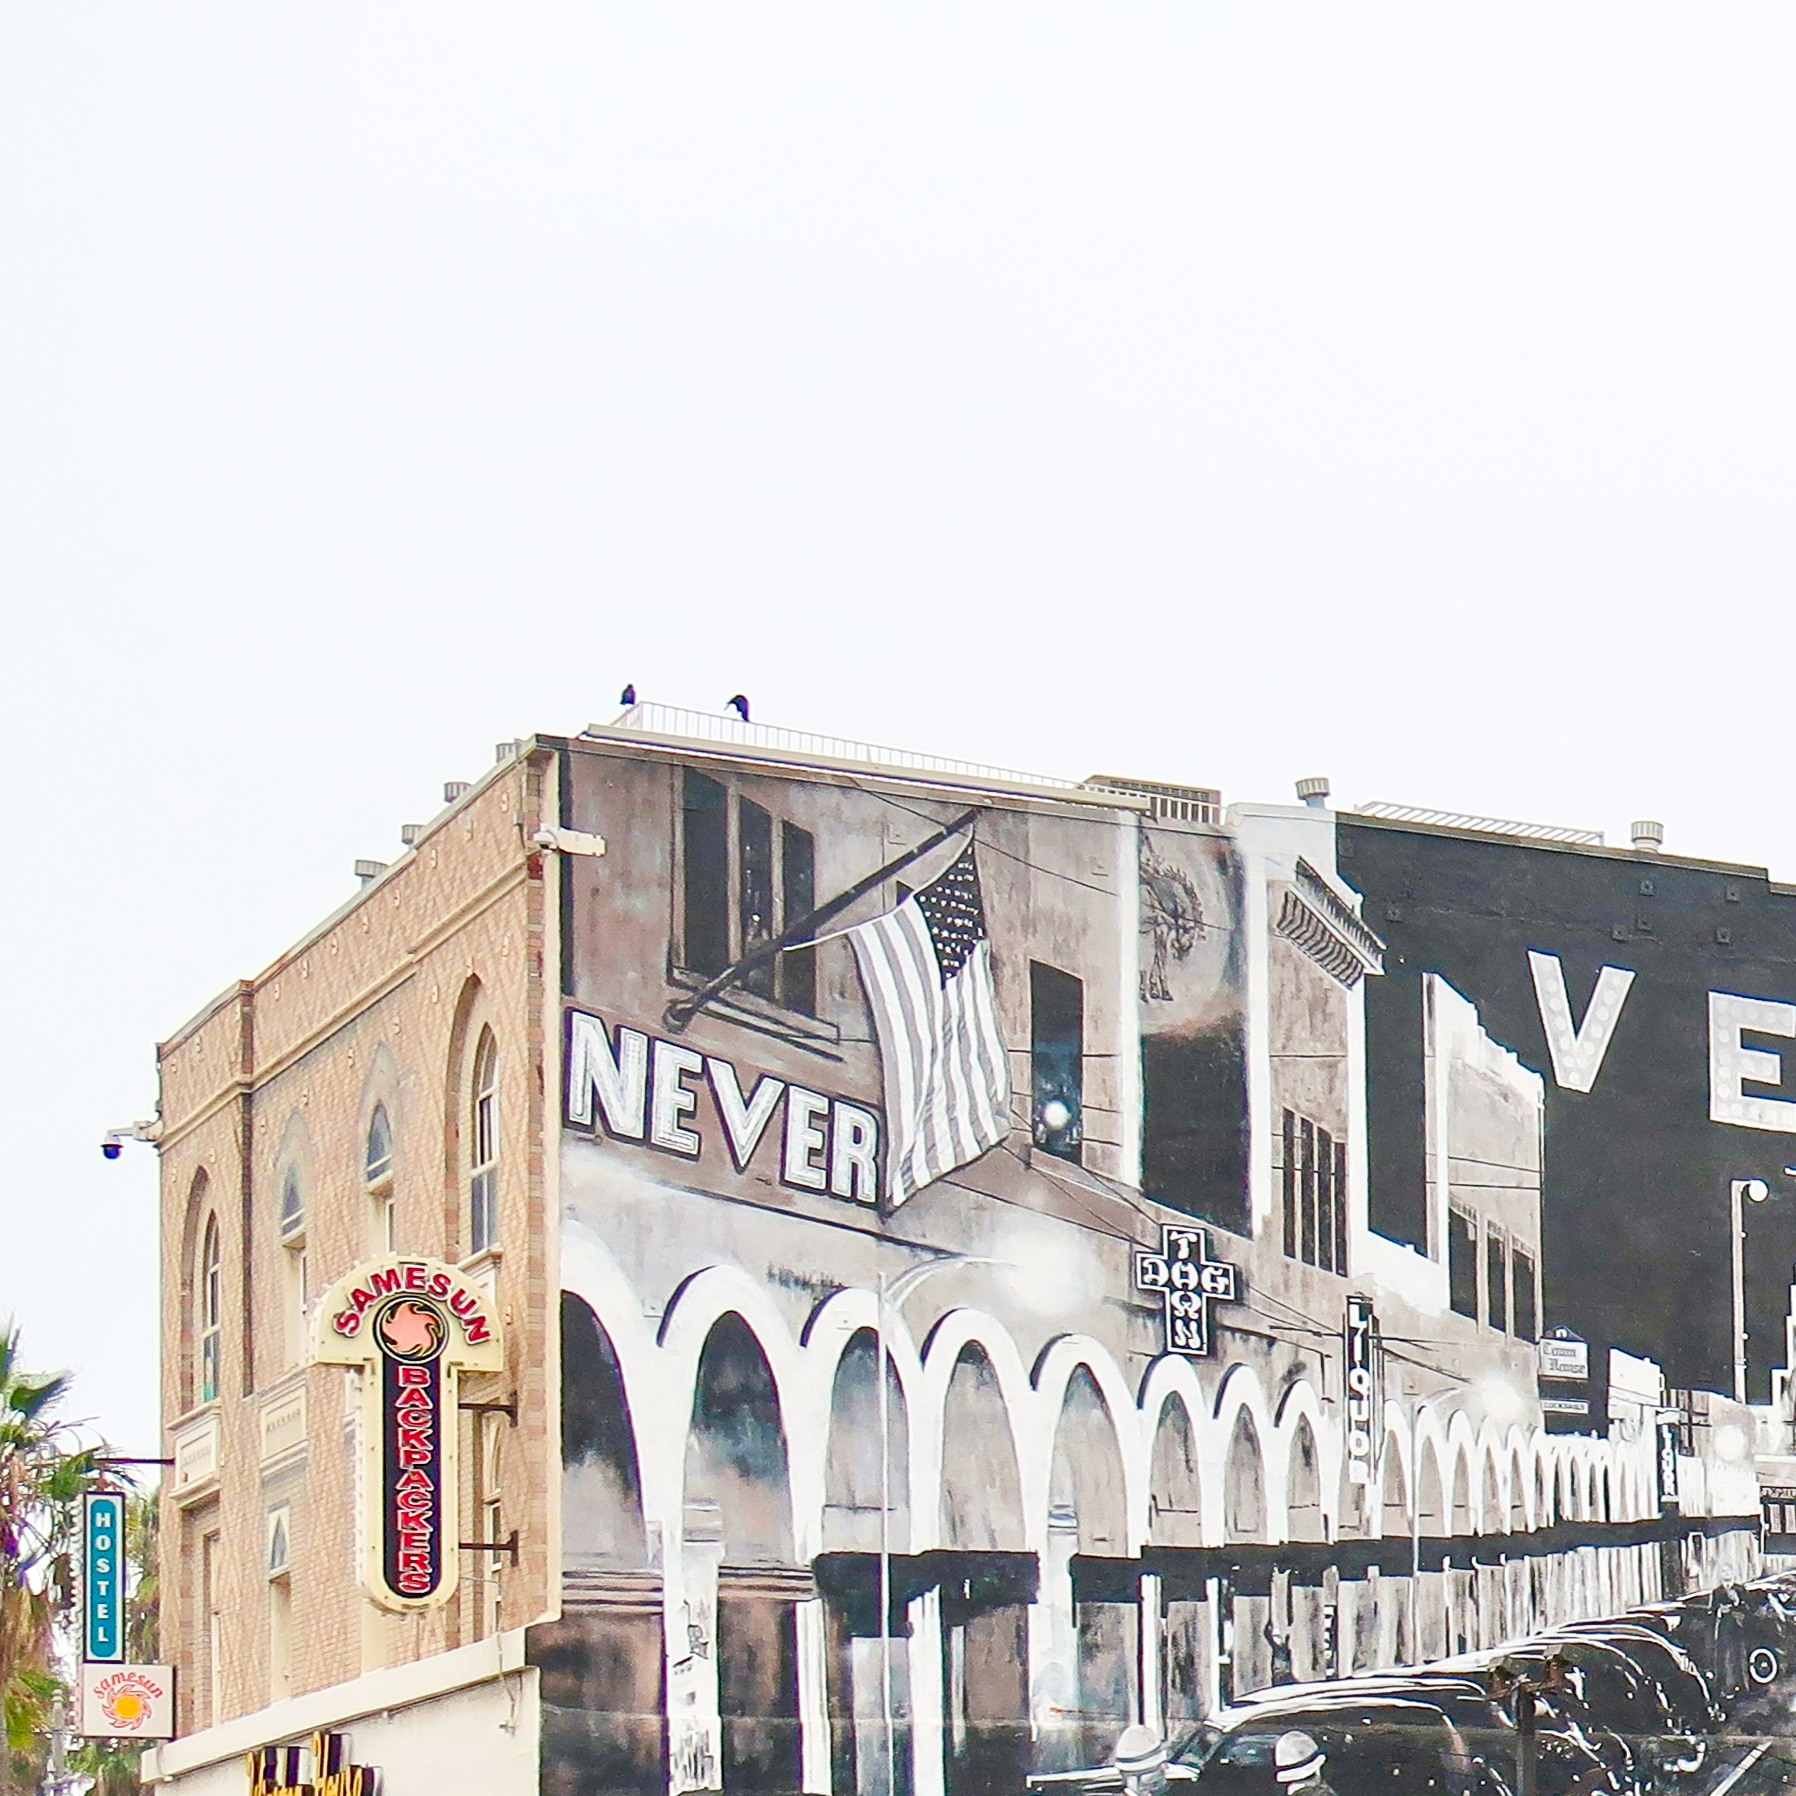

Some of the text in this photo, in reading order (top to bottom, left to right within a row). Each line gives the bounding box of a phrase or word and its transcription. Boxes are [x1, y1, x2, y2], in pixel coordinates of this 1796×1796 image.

[566, 1007, 879, 1204] NEVER
[333, 1265, 490, 1344] SAMESUN
[1142, 1258, 1229, 1294] DOG
[1349, 1303, 1370, 1484] LIQUOR
[395, 1366, 432, 1593] BACKPACKERS
[95, 1512, 111, 1643] HOSTEL
[92, 1671, 163, 1699] samesun
